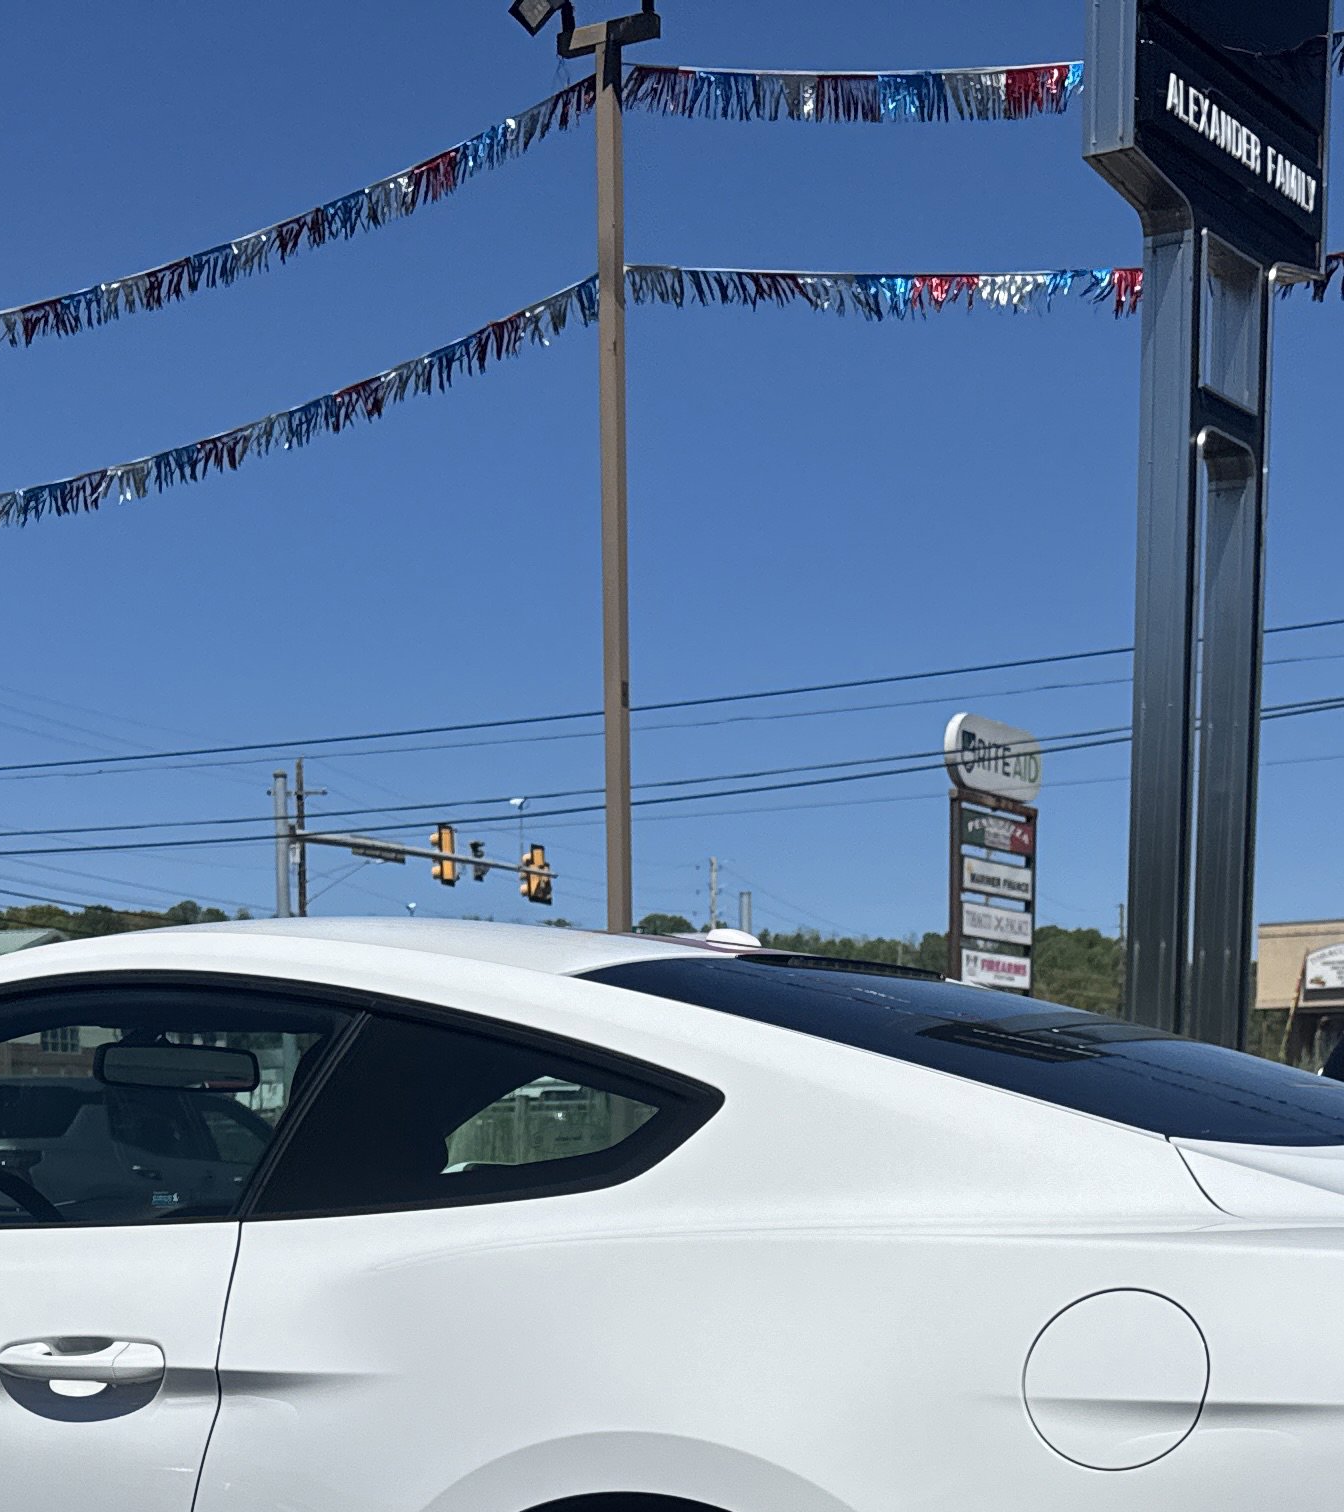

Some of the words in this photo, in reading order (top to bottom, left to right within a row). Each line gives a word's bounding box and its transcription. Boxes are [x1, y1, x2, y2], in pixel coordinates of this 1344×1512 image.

[1166, 72, 1261, 175] ALEXANDER
[1266, 145, 1316, 213] FAMILY
[1013, 754, 1041, 784] AID
